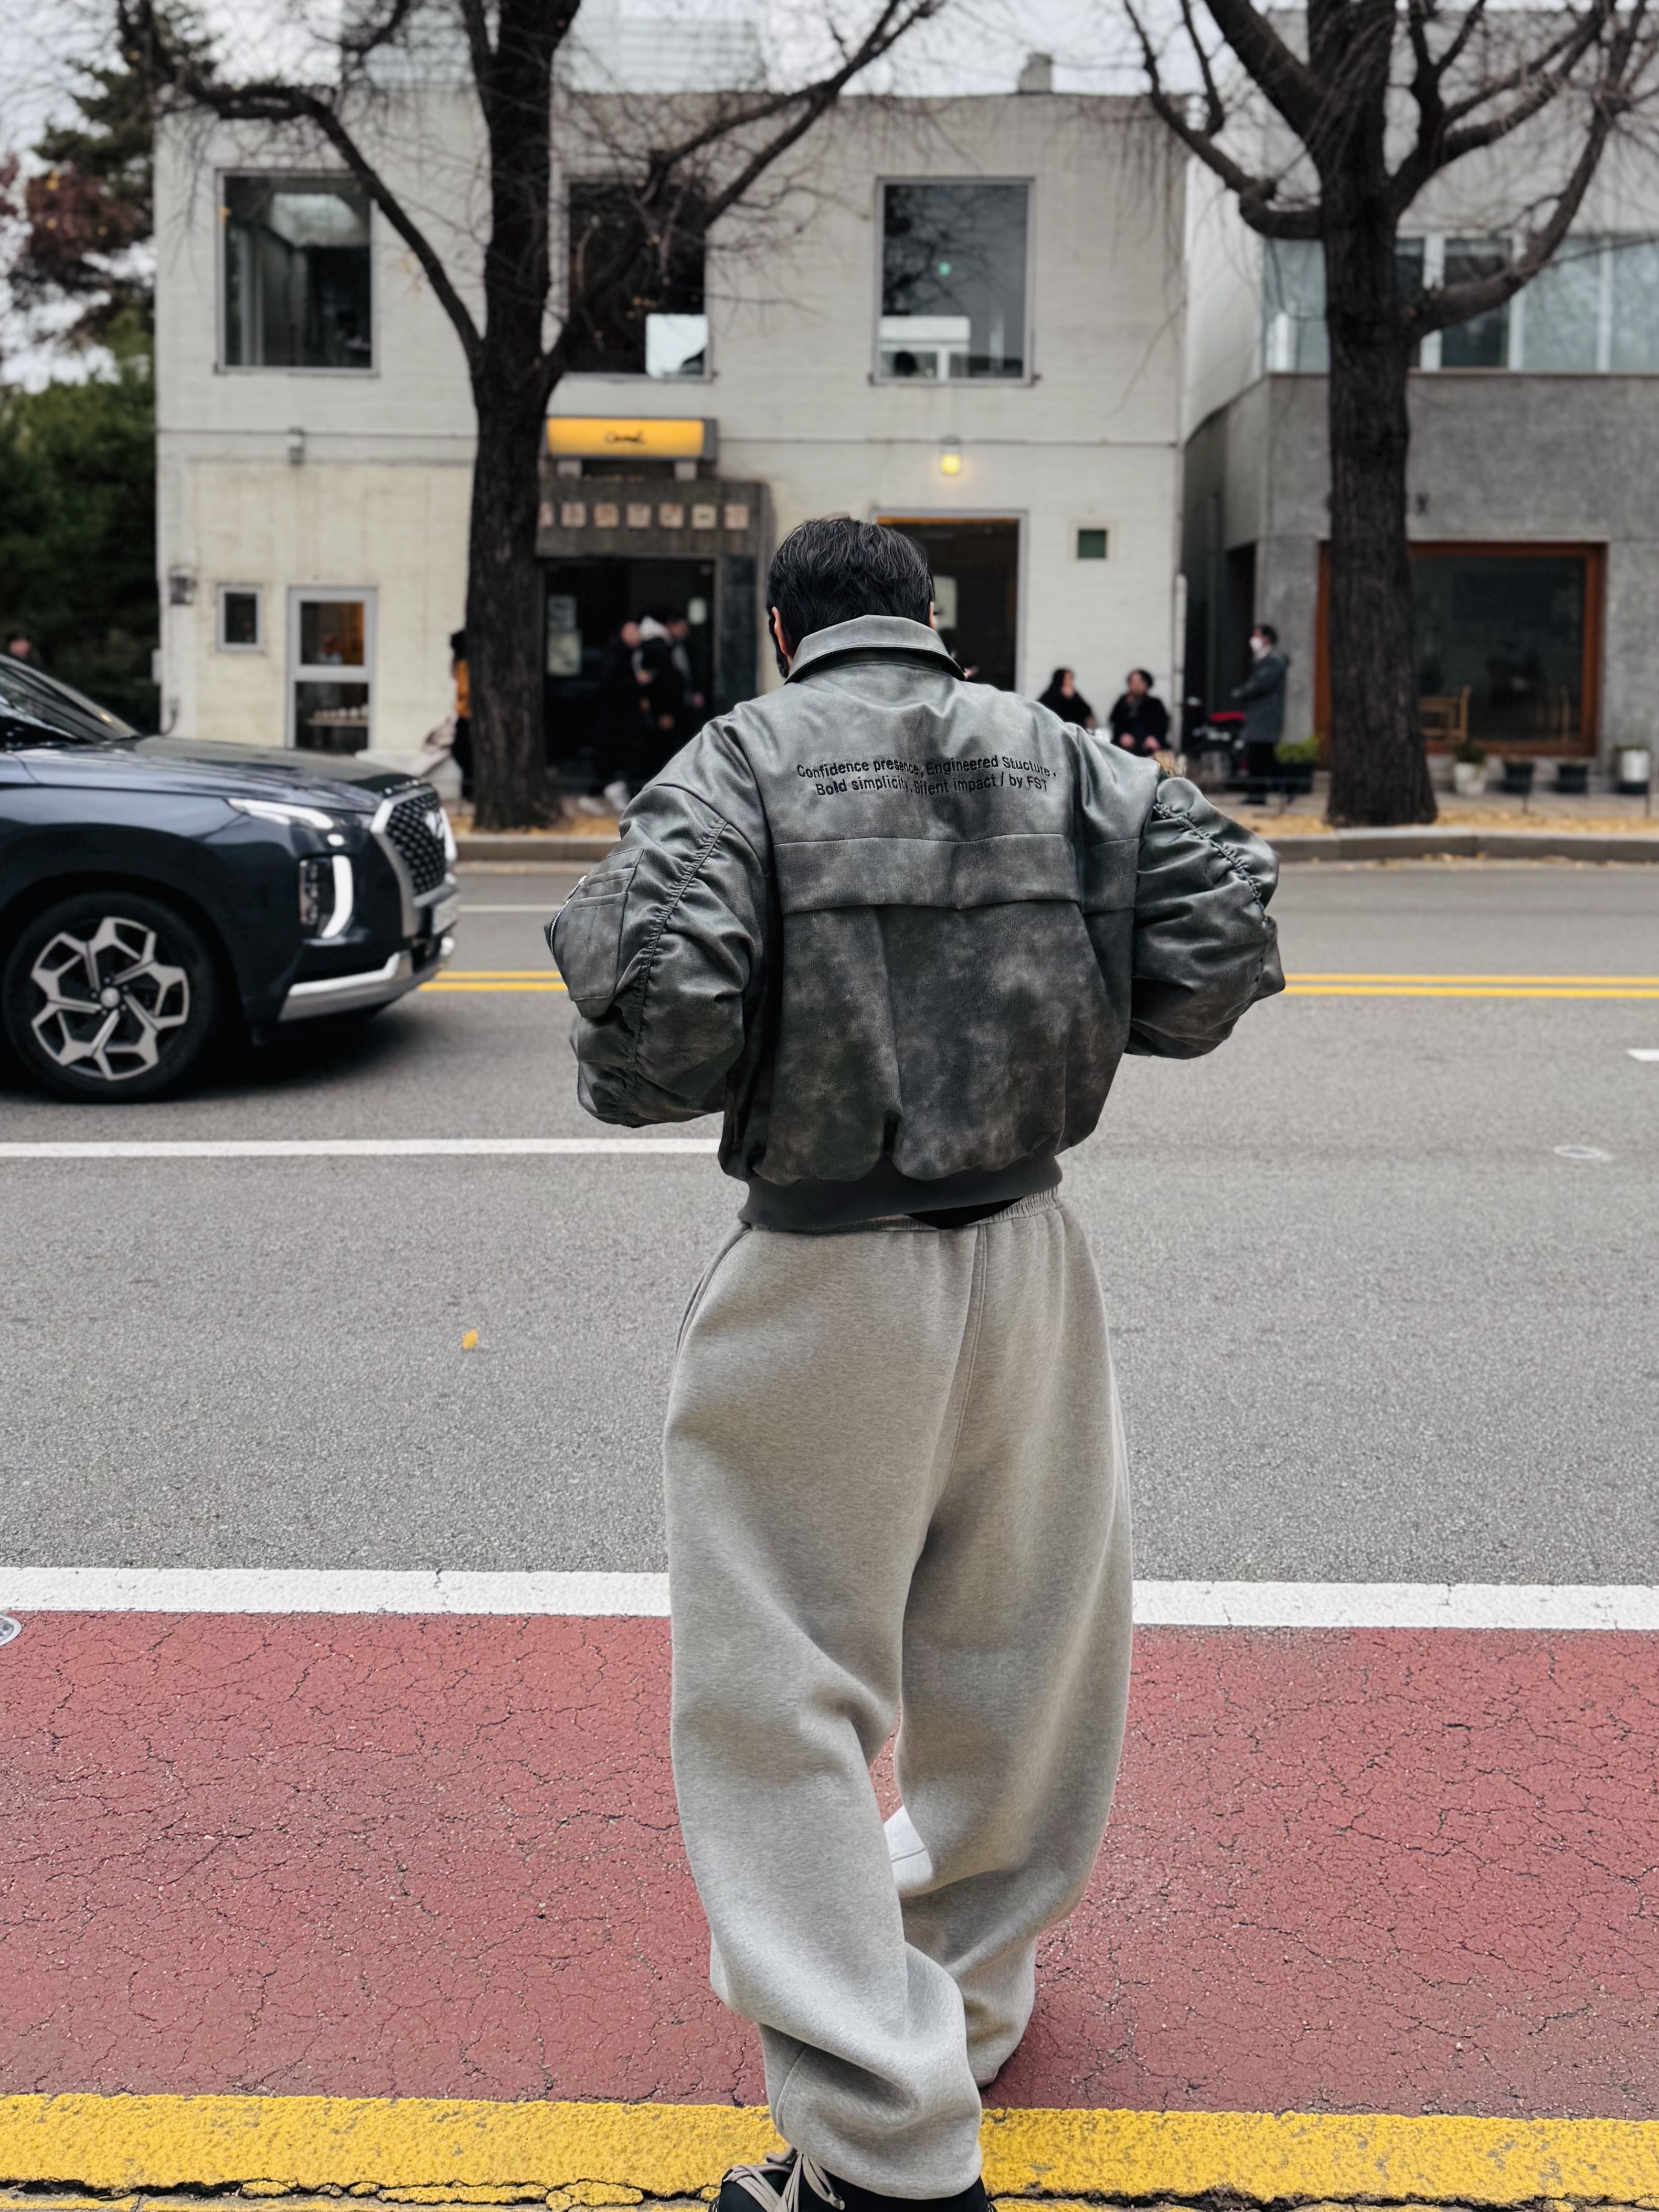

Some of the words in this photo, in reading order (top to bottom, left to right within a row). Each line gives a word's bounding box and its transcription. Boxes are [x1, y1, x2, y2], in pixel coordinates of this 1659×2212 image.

[797, 762, 869, 779] Confidence
[926, 755, 998, 775] Engineered
[815, 779, 847, 795] Bold
[953, 774, 996, 792] impact
[1008, 773, 1023, 789] by
[1026, 775, 1047, 792] FST
